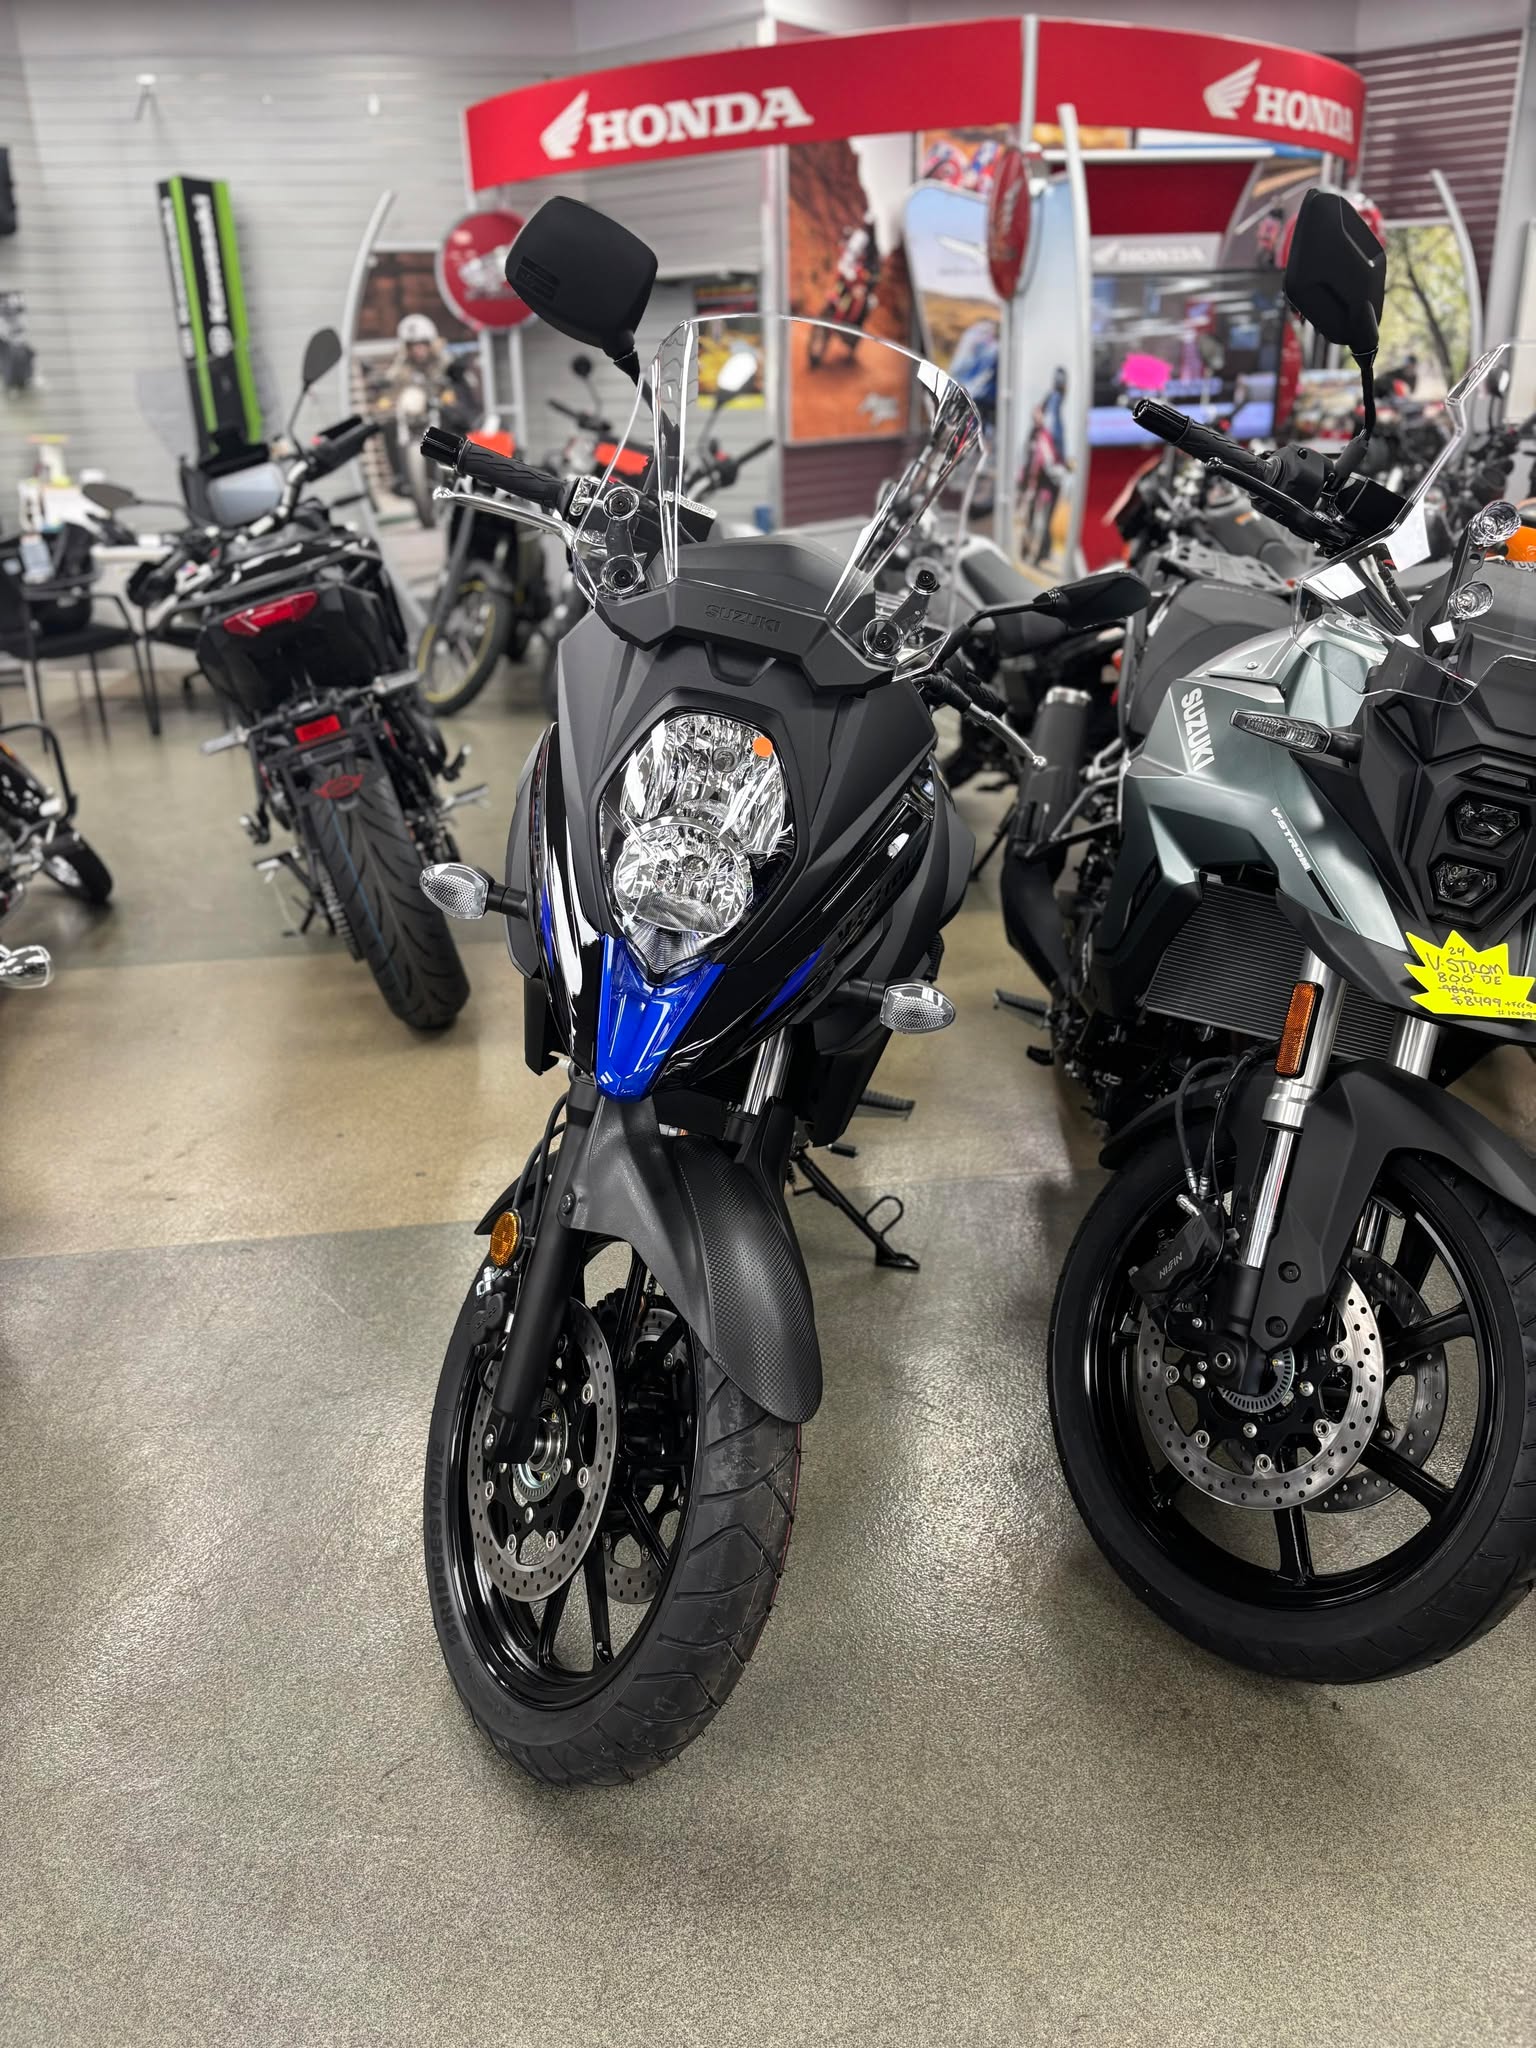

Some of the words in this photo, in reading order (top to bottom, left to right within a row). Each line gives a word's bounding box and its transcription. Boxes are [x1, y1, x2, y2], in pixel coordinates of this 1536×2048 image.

[587, 86, 815, 154] HONDA
[1253, 83, 1355, 144] HONDA
[705, 604, 782, 633] SUZUKI
[1181, 687, 1215, 772] SUZUKI
[1270, 806, 1311, 871] V-STROM
[1437, 972, 1473, 983] 800
